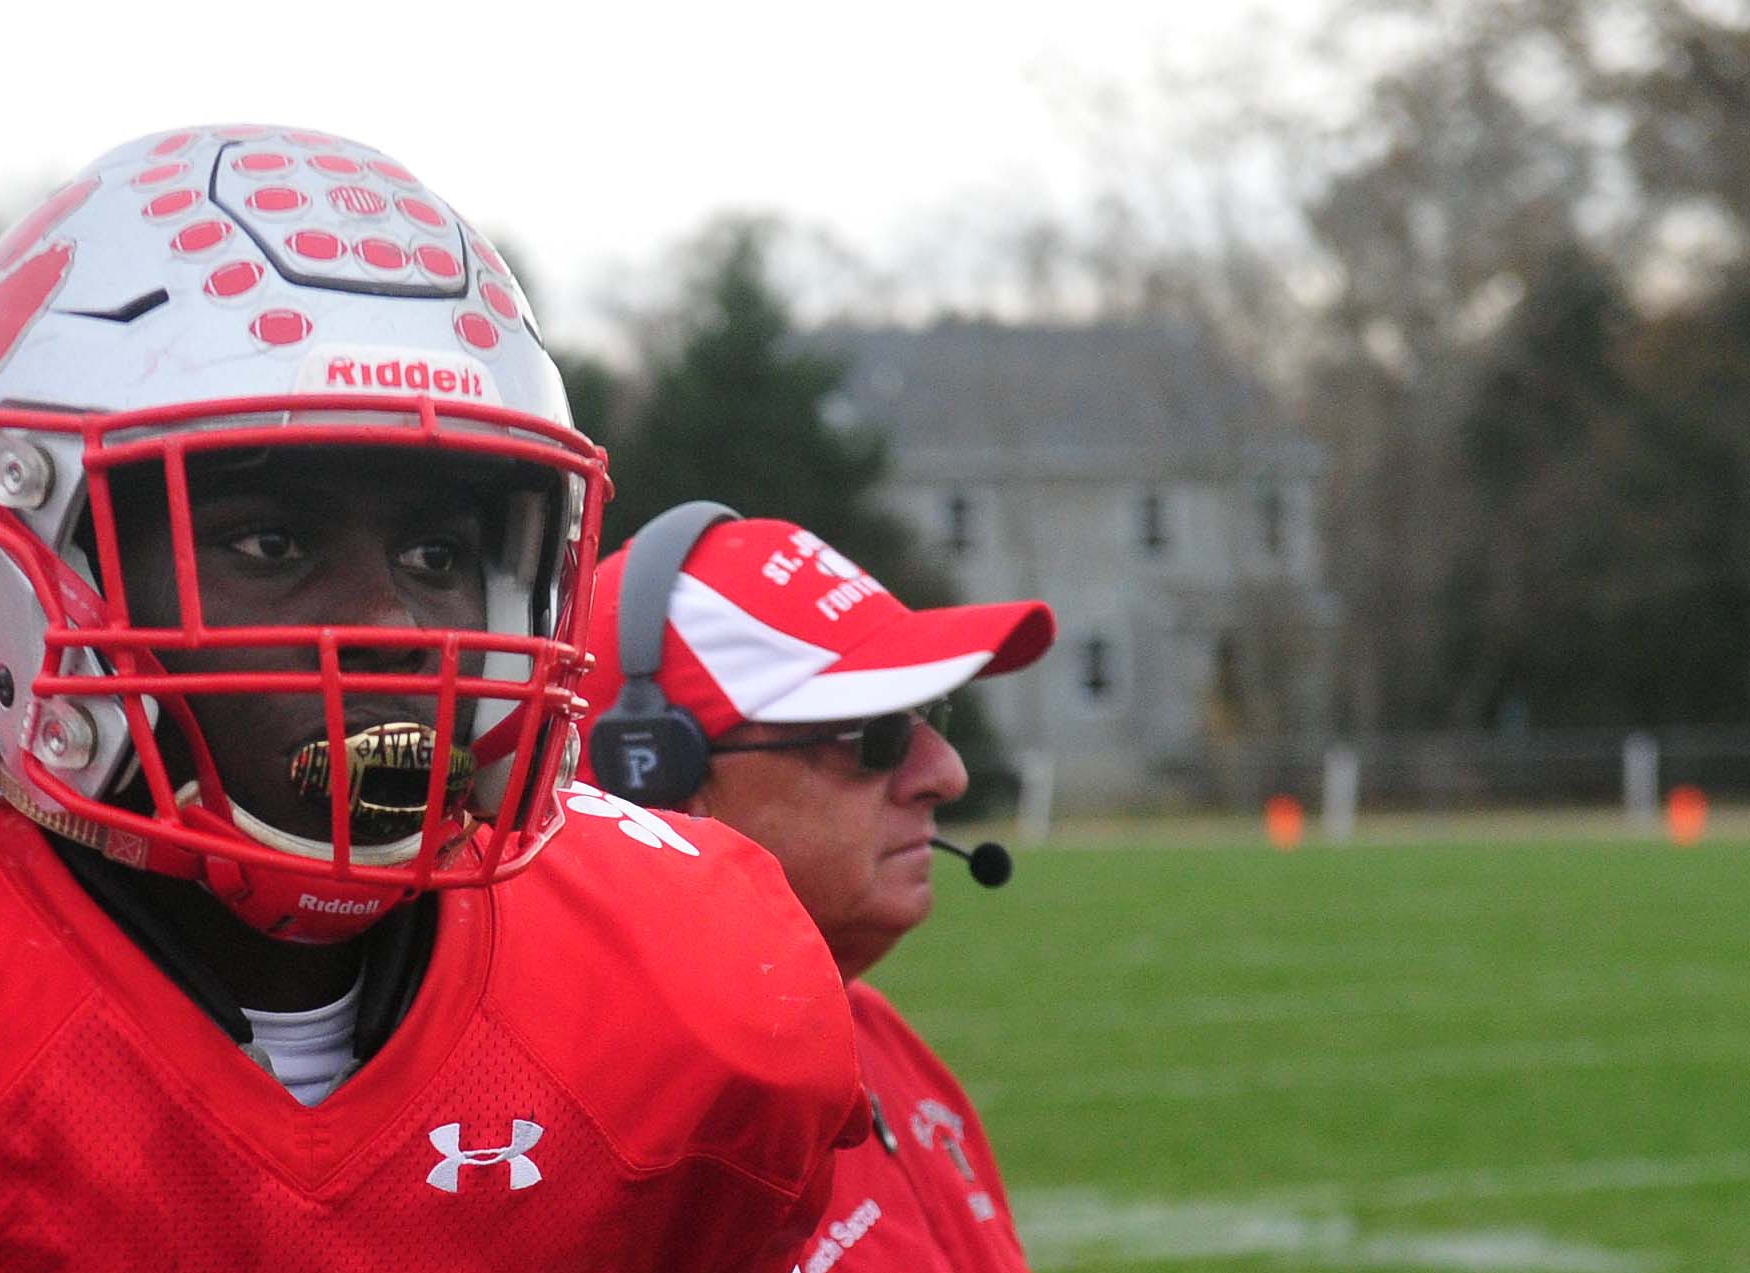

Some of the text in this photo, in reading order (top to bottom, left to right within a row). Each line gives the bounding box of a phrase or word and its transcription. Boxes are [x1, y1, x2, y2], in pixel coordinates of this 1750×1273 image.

[327, 356, 483, 397] Riddell
[762, 551, 803, 586] ST.
[297, 893, 380, 915] Riddell
